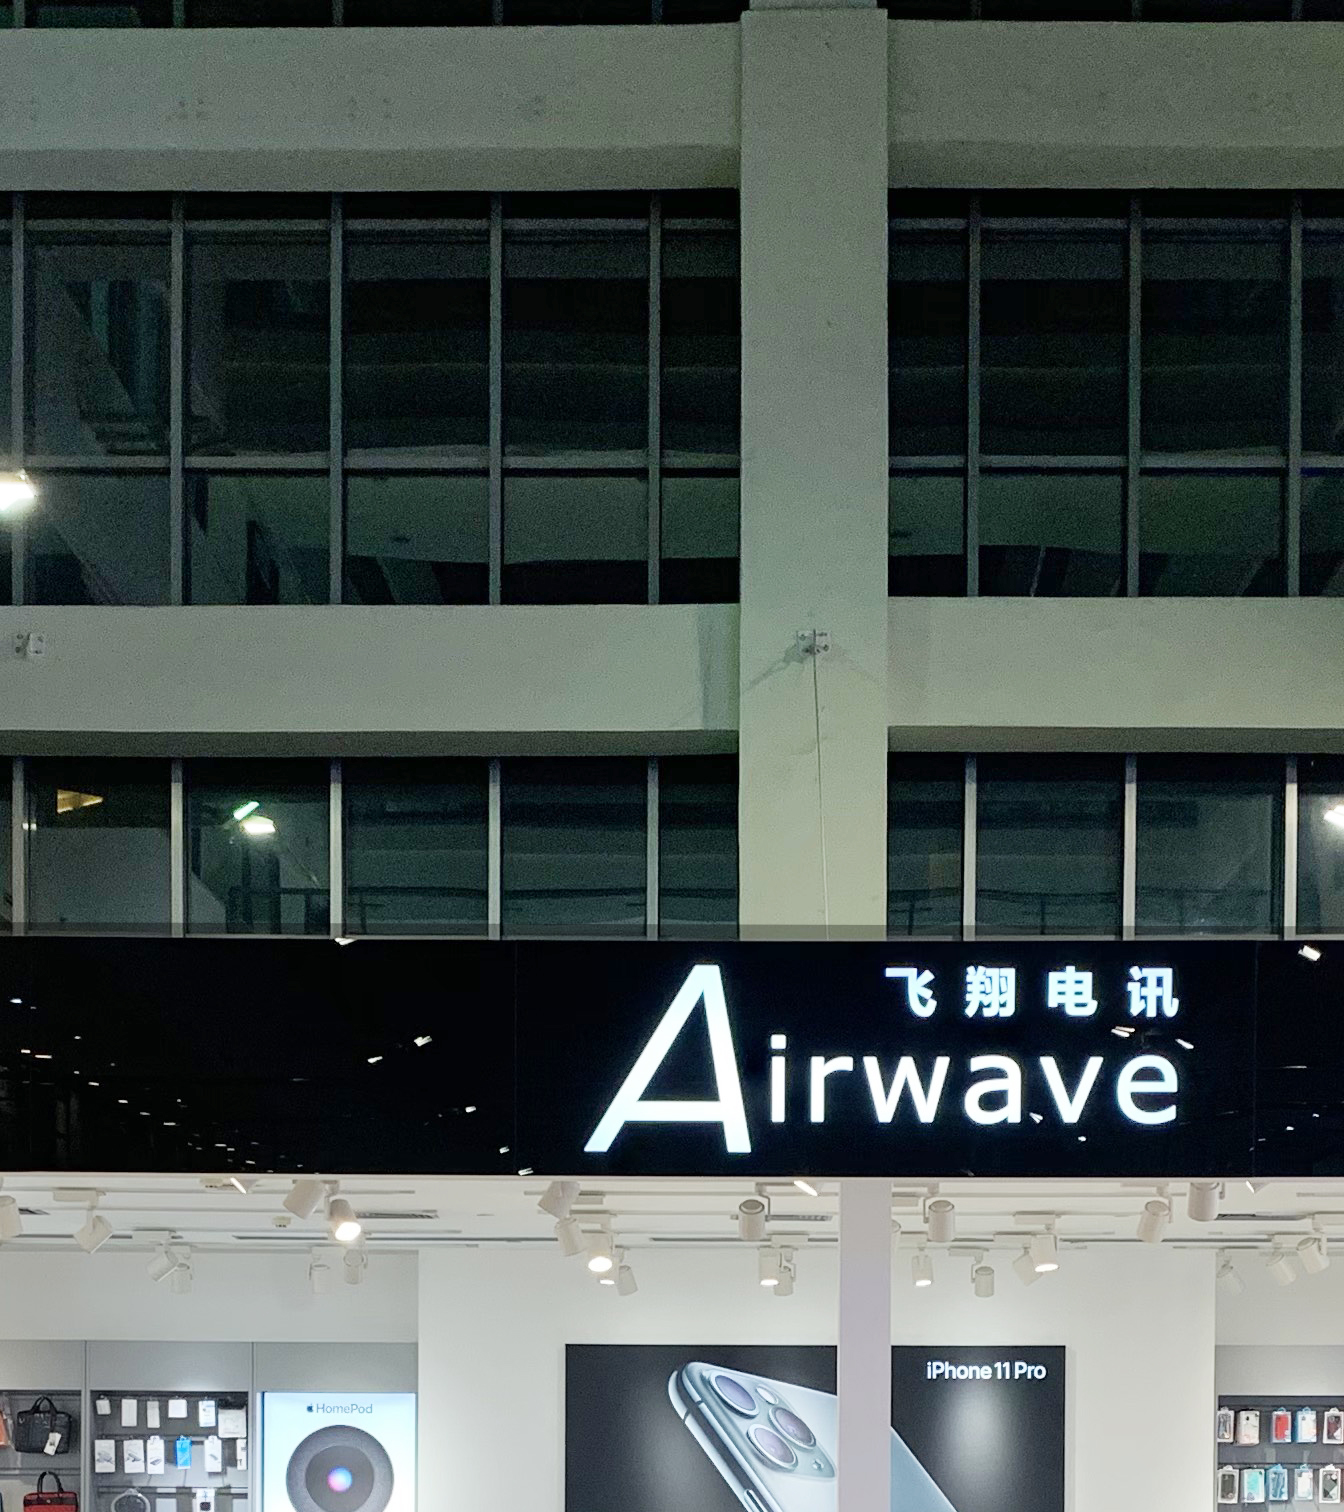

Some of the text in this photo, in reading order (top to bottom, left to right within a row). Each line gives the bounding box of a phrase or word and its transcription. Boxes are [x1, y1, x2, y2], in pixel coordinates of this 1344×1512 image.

[885, 966, 1179, 1018] 飞翔电讯
[584, 964, 1179, 1153] Airwave
[927, 1361, 1047, 1379] iPhone 11 Pro
[316, 1403, 373, 1414] HomePod
